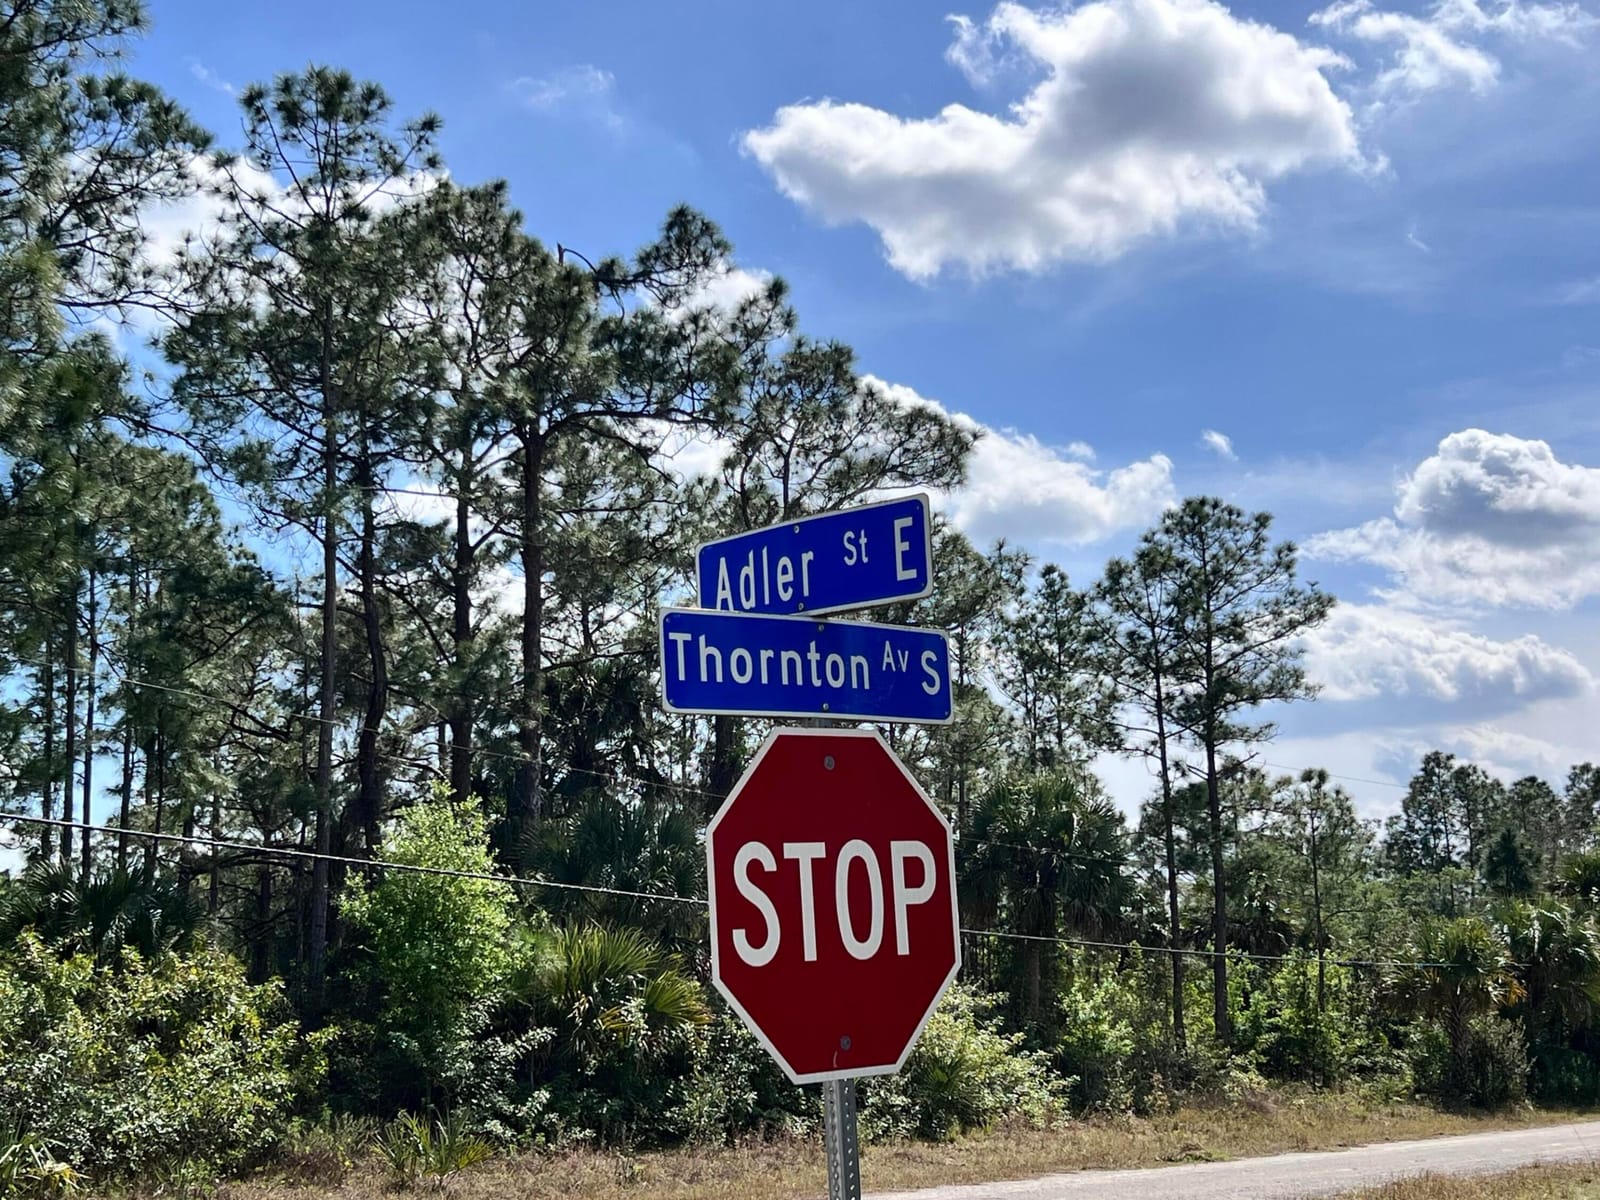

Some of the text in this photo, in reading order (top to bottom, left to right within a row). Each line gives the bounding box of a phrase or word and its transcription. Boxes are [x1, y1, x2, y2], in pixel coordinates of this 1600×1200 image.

[716, 517, 917, 611] Adler St E
[668, 632, 941, 695] Thornton Av S
[732, 839, 937, 967] STOP
